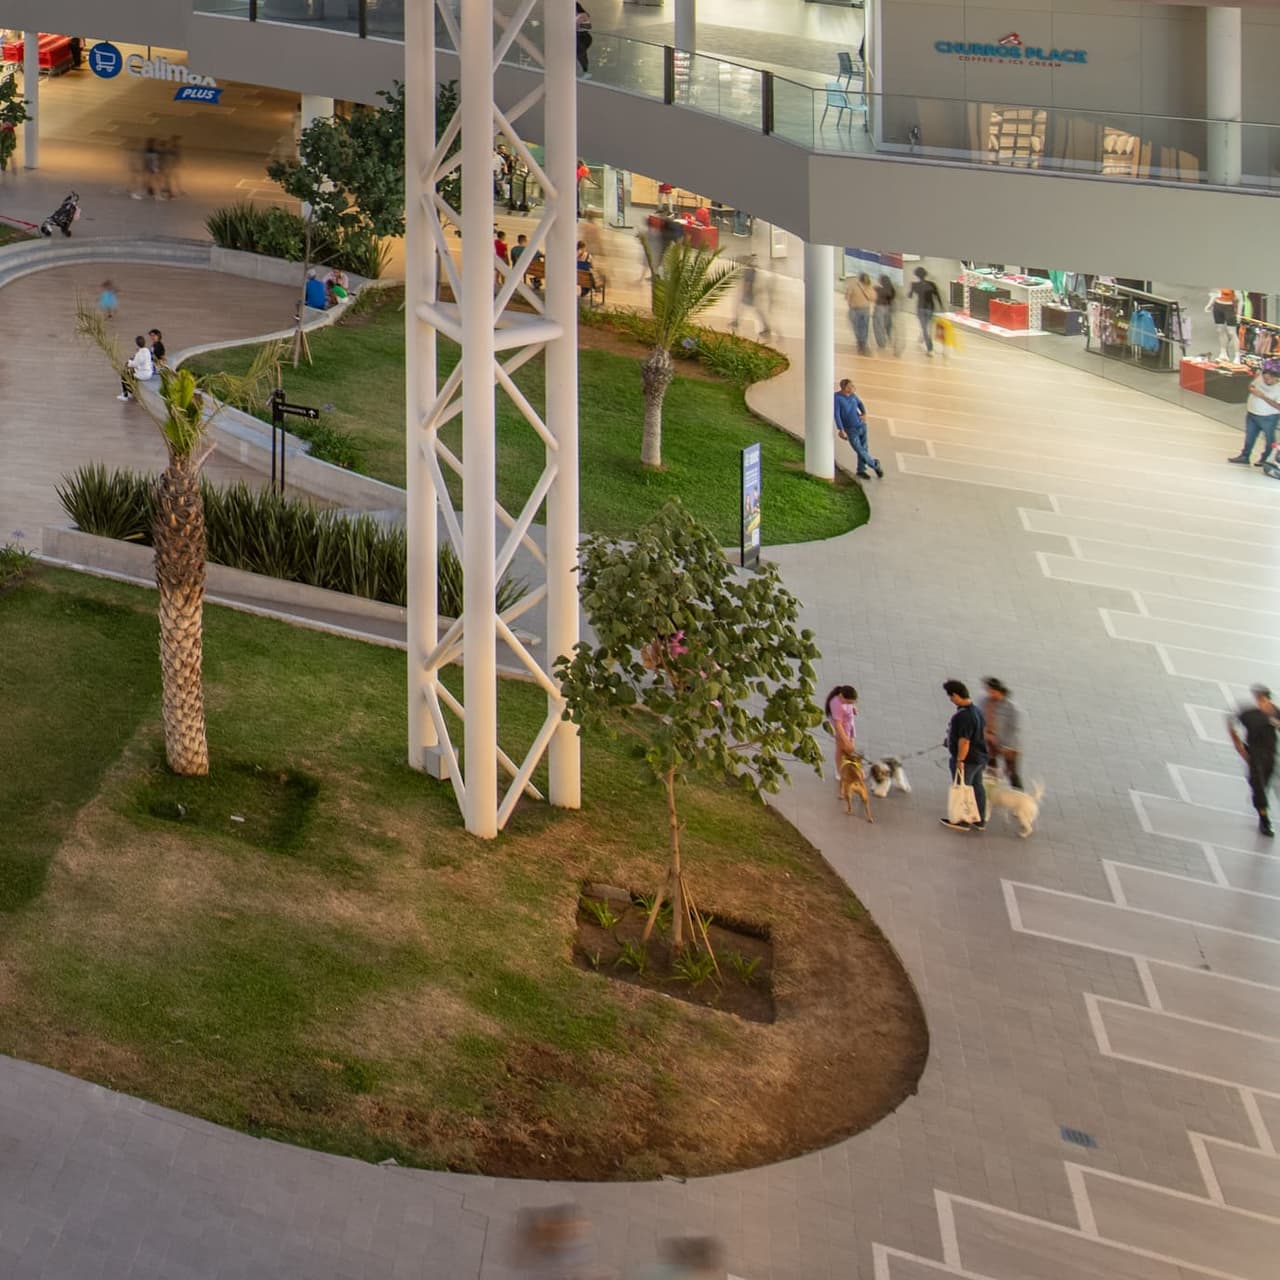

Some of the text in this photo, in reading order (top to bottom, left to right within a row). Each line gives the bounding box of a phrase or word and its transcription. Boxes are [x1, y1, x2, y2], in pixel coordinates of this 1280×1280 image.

[934, 40, 1088, 64] CHURROS PLACE
[958, 54, 993, 63] COFFEE
[181, 88, 215, 100] PLUS
